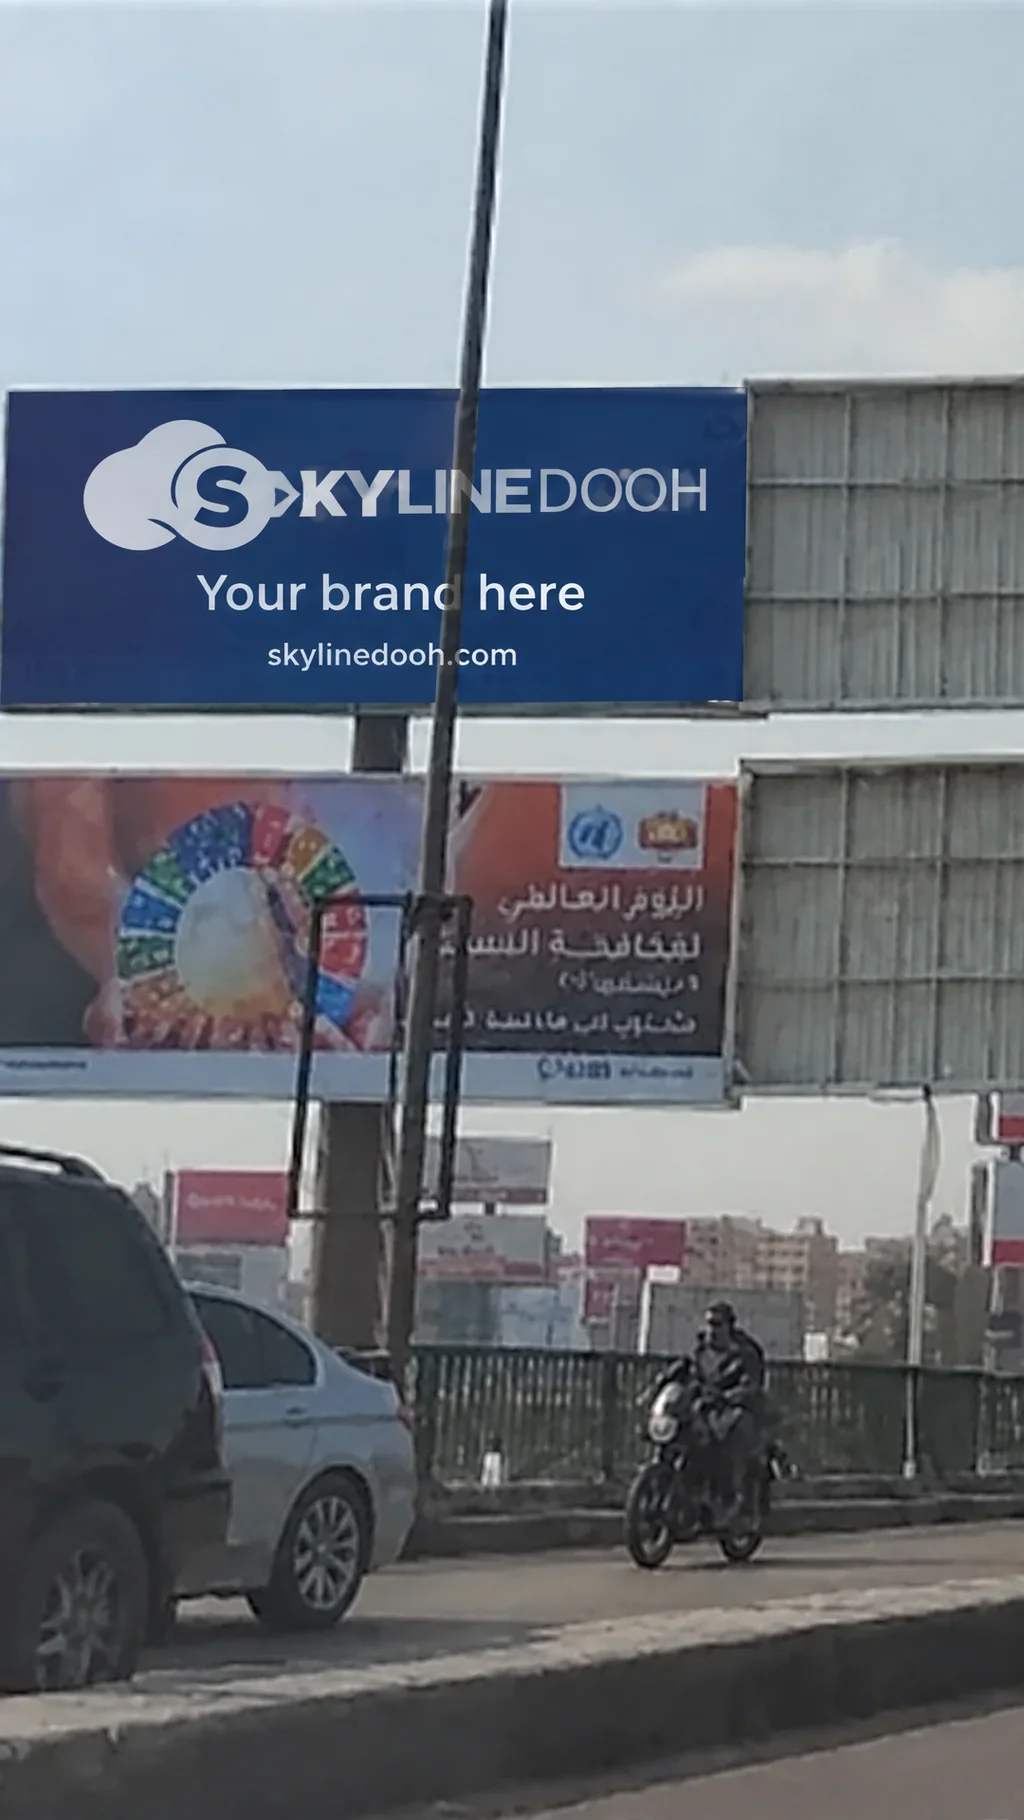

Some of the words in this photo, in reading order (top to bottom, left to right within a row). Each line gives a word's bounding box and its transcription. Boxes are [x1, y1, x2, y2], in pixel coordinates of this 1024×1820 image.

[197, 574, 306, 611] Your
[479, 573, 586, 612] here
[267, 642, 518, 671] skylinedooh.com
